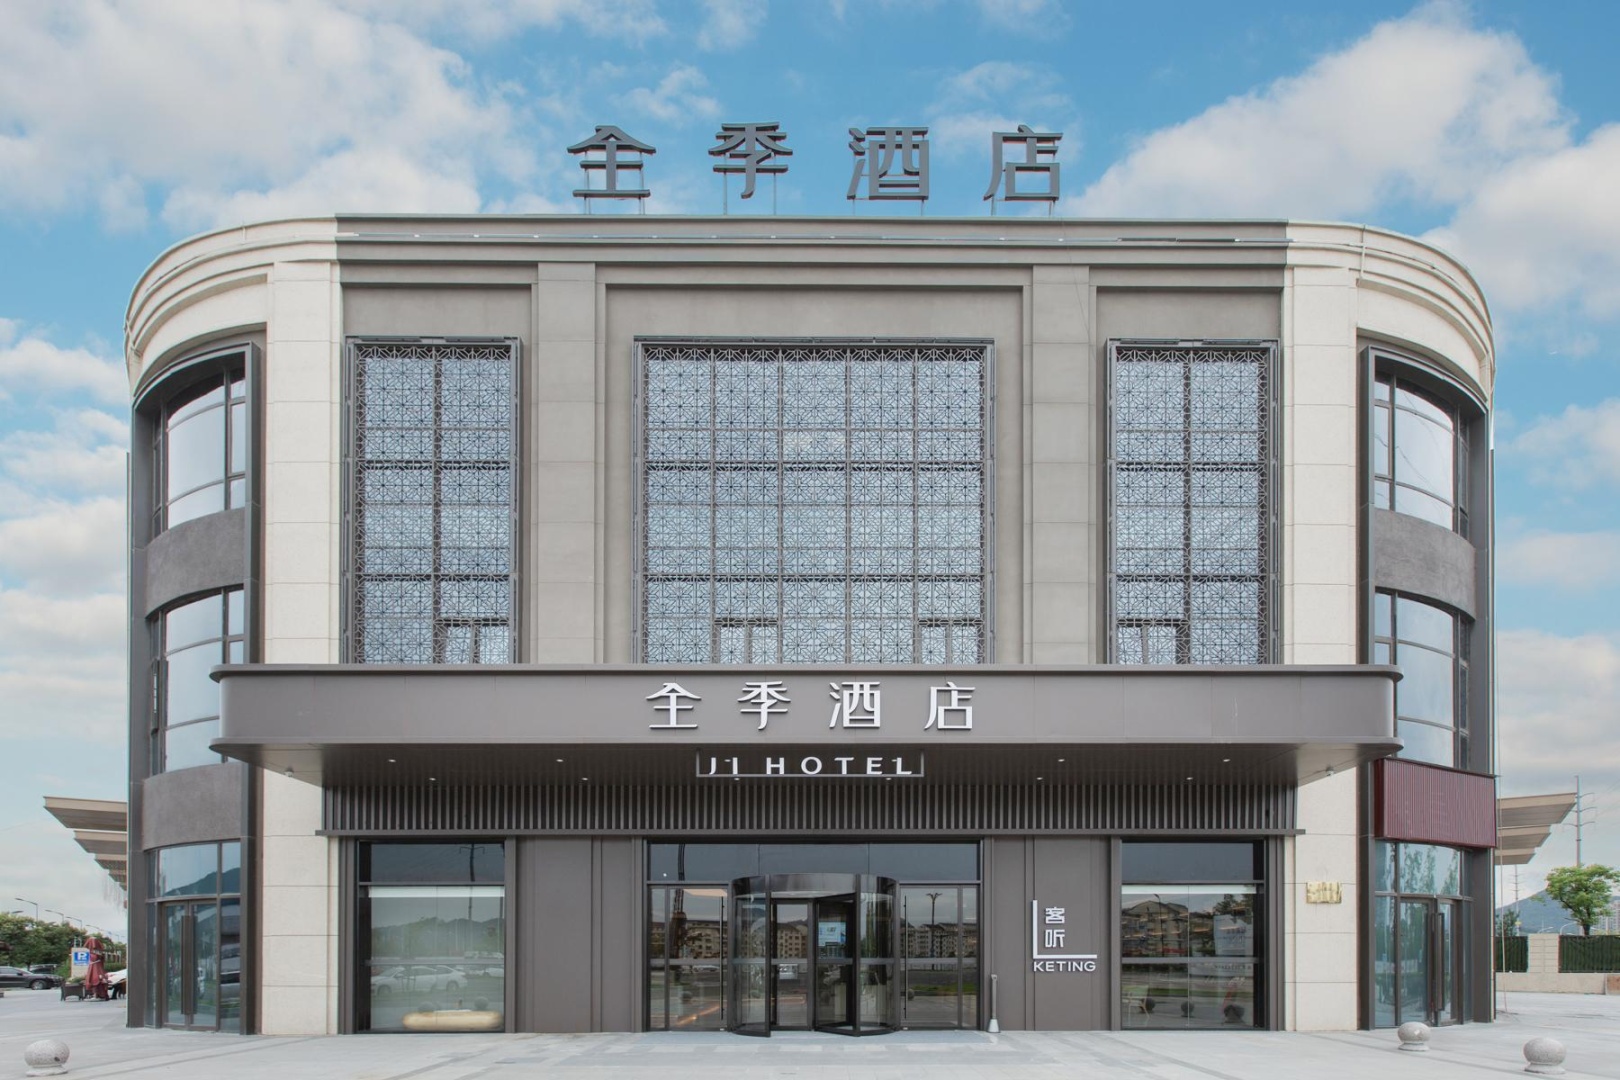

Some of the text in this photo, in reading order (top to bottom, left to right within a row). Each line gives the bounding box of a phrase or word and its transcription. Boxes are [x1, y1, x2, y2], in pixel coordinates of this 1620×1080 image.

[567, 121, 1063, 201] 全季酒店
[646, 681, 975, 730] 全季酒店
[709, 757, 912, 775] JI HOTEL
[1033, 961, 1096, 972] KETING
